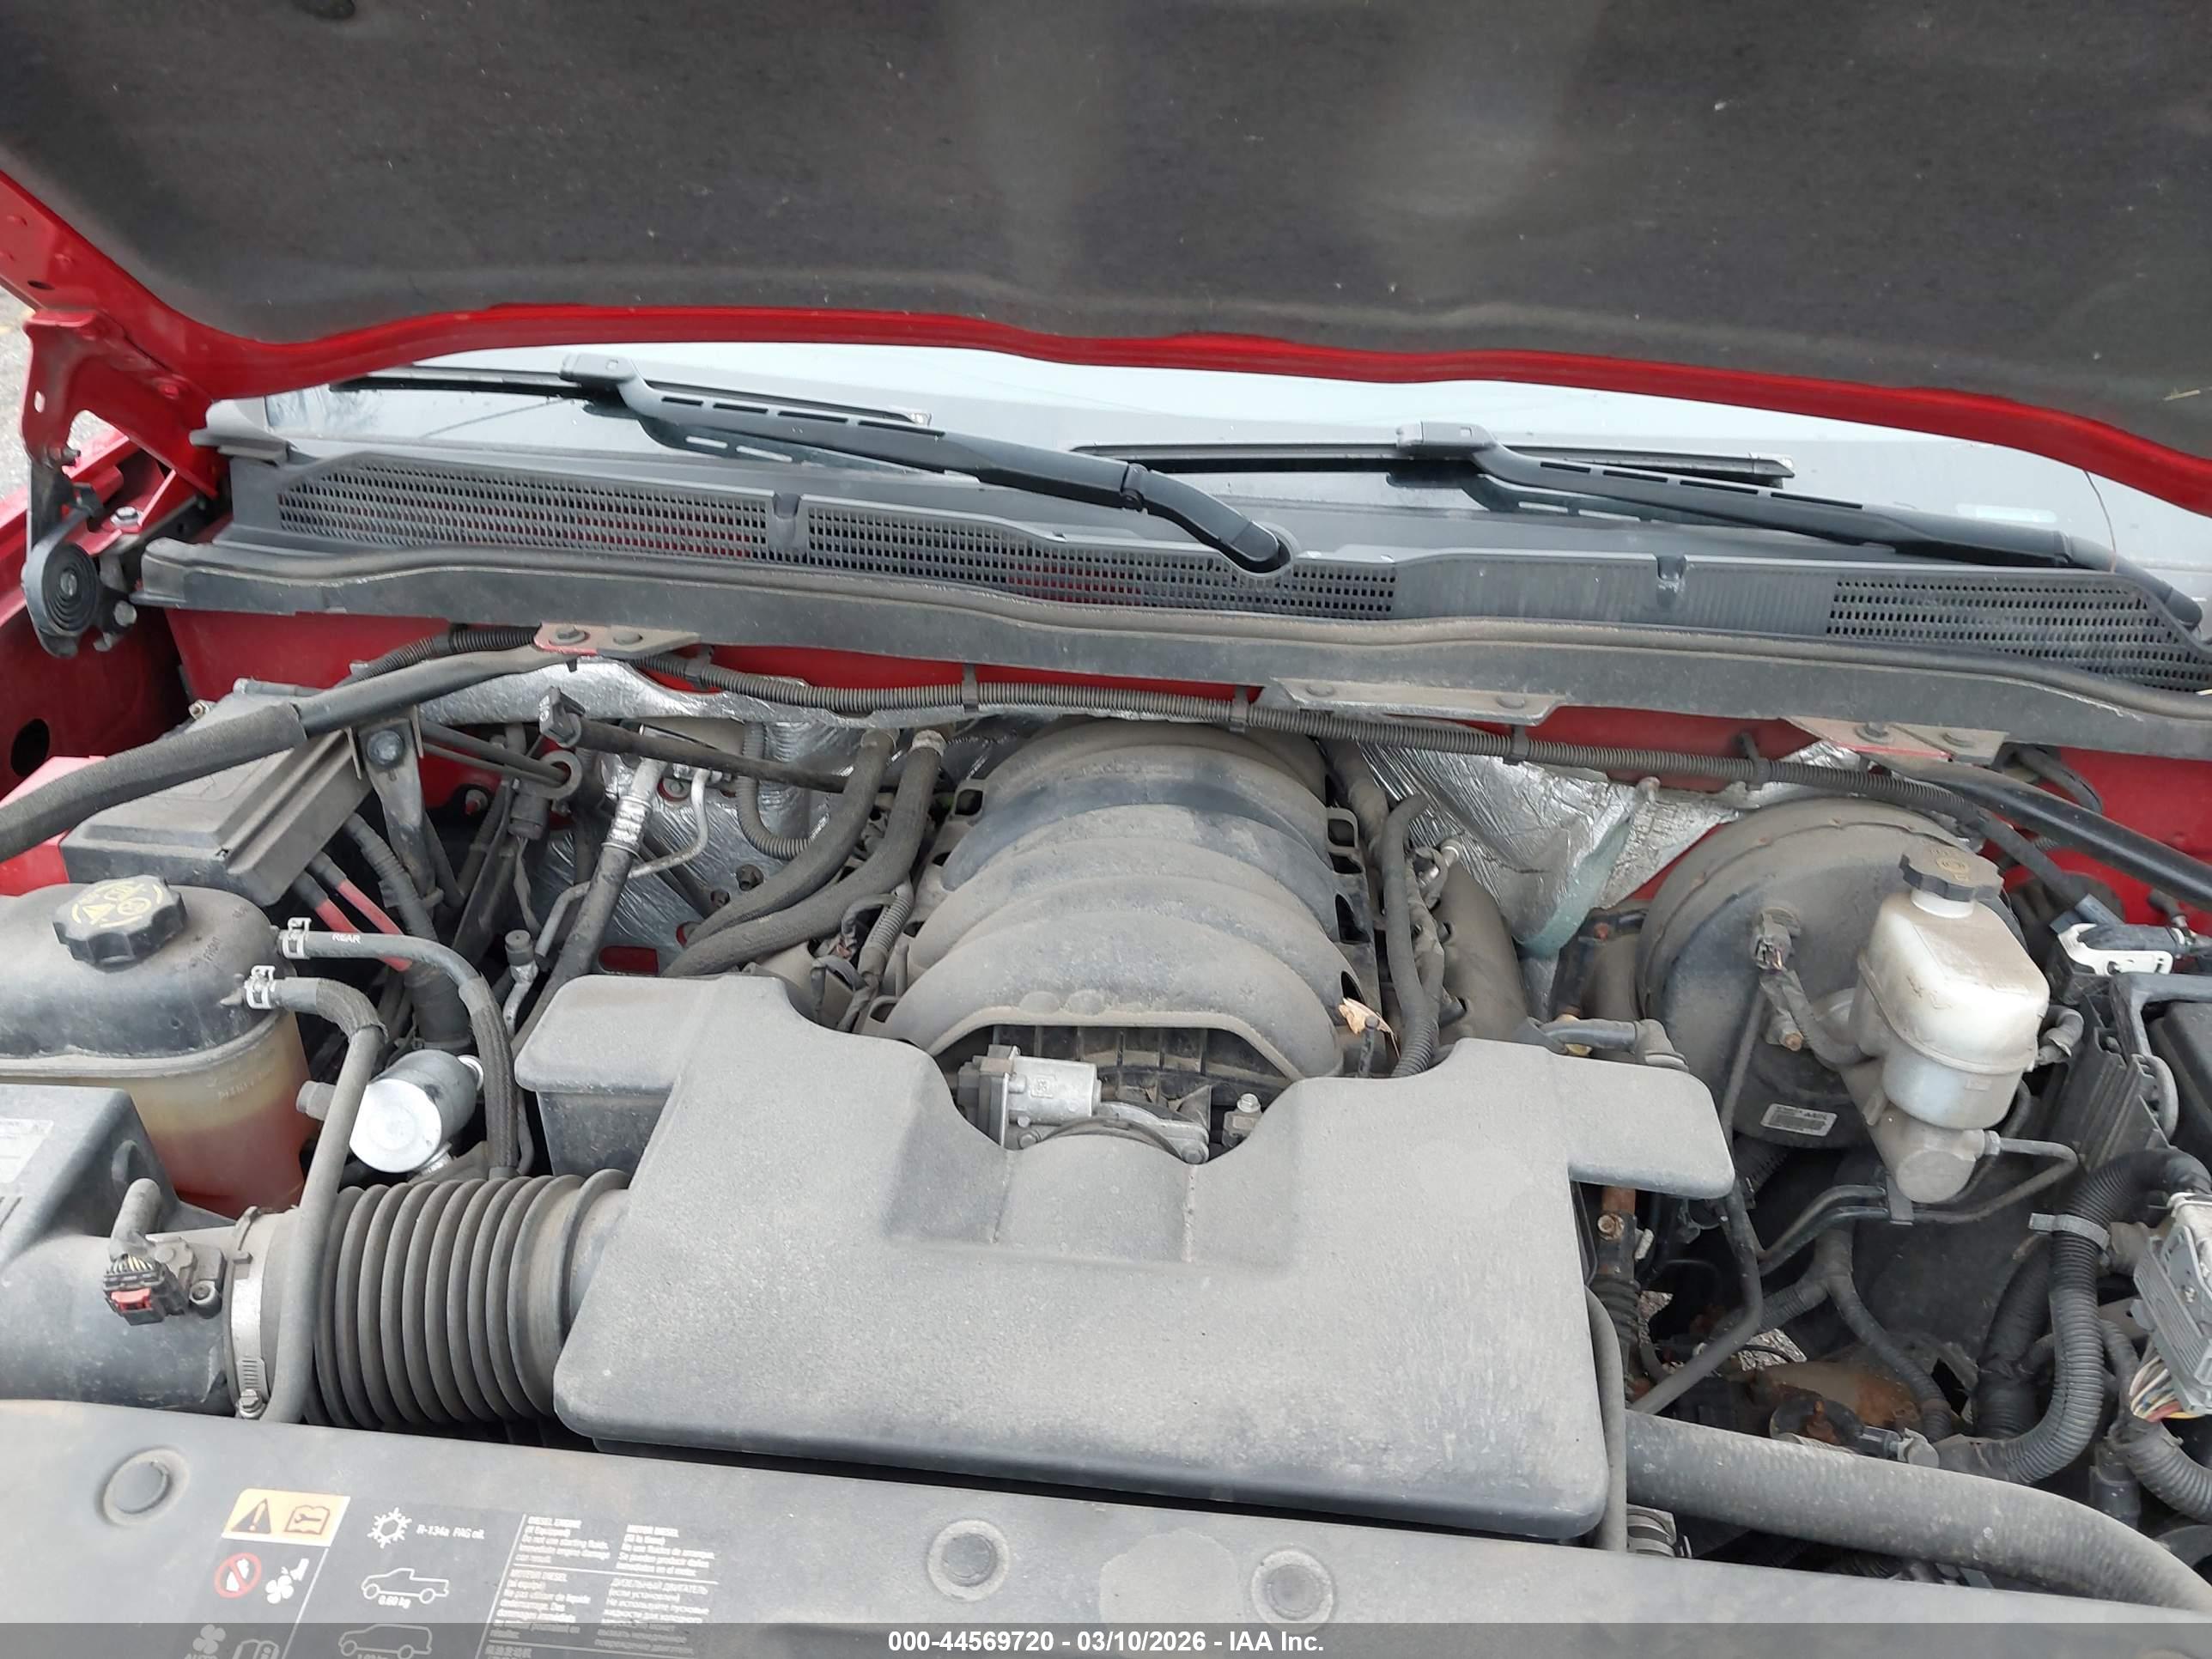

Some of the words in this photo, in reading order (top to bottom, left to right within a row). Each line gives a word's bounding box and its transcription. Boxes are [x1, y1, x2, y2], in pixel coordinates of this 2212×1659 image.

[331, 933, 362, 944] REAR
[416, 1524, 450, 1537] R-134a
[453, 1527, 471, 1539] PAG
